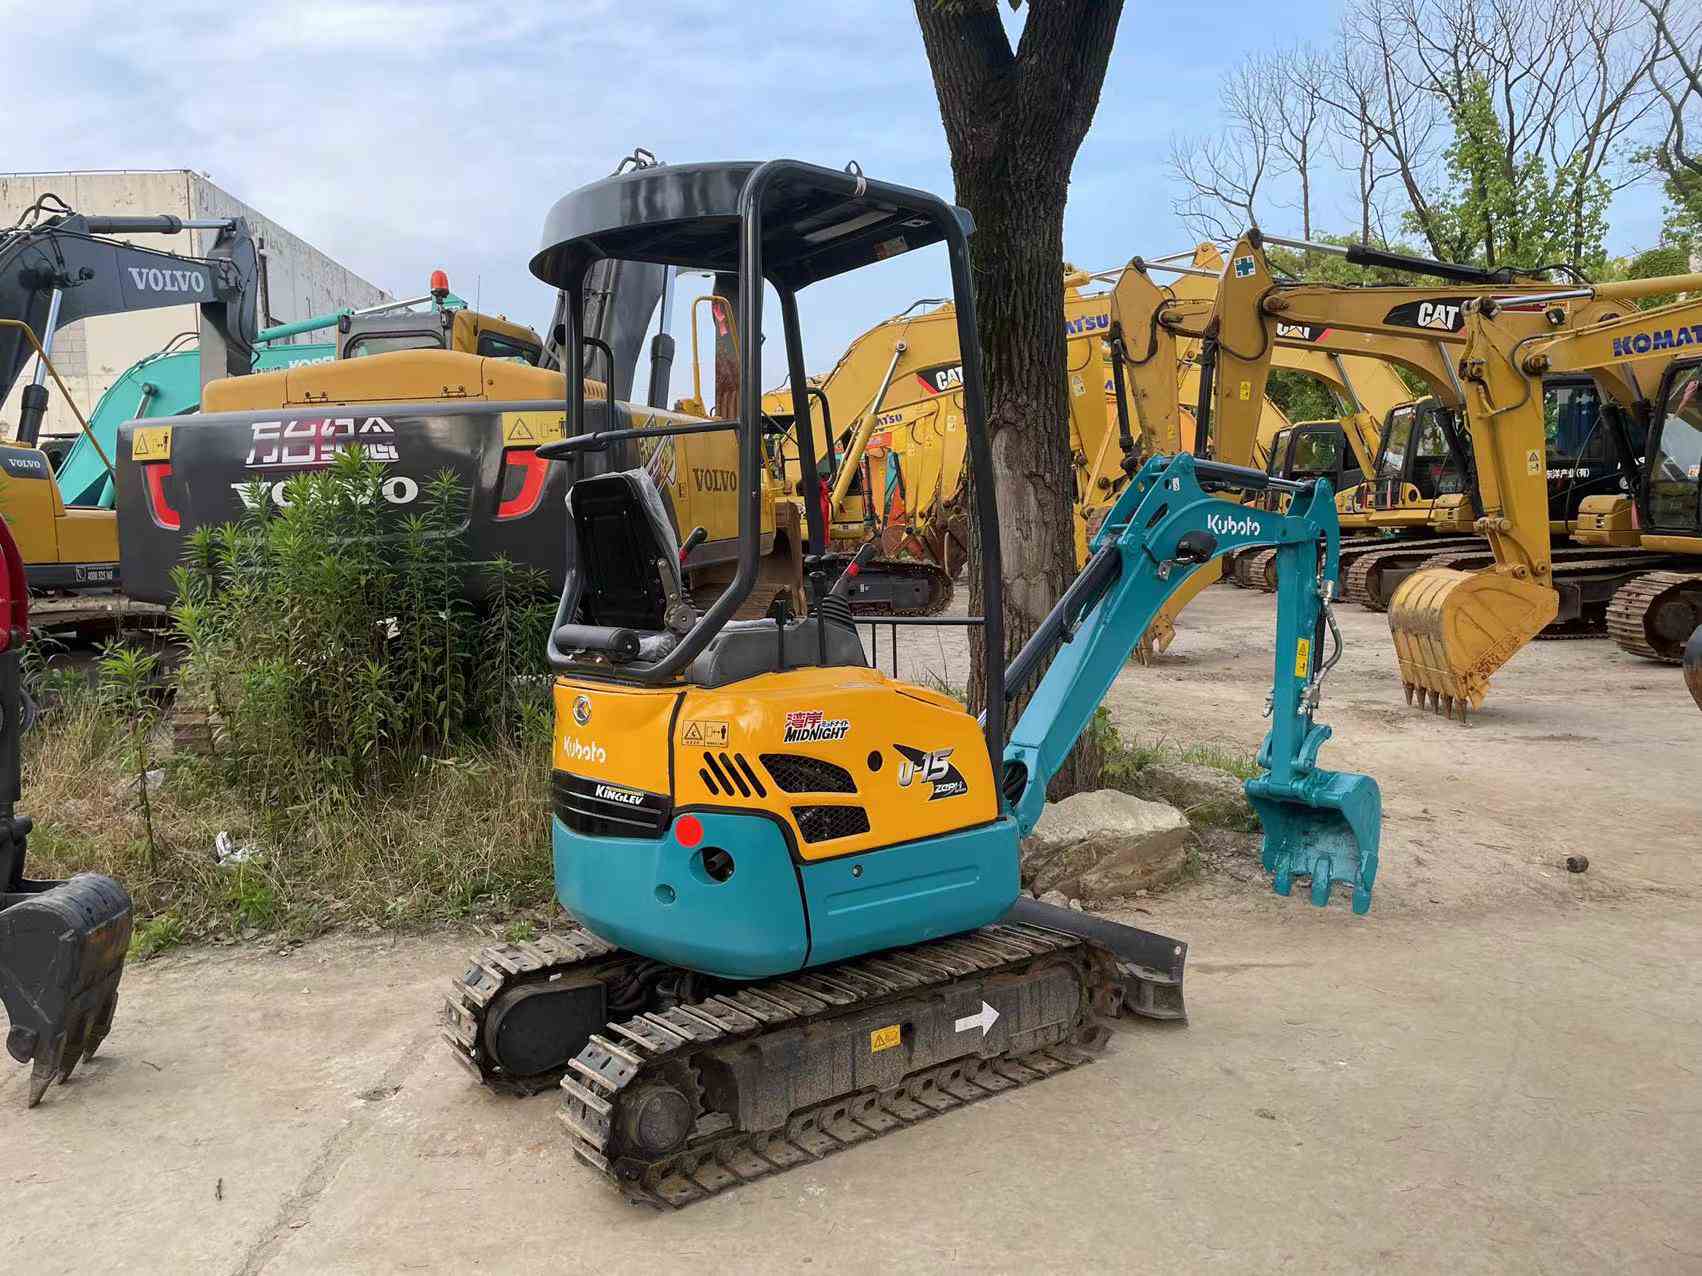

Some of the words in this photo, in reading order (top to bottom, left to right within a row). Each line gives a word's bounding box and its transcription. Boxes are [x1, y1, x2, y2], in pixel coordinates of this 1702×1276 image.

[128, 267, 204, 292] VOLVO
[1064, 314, 1110, 334] ATSU
[1417, 303, 1460, 330] CAT
[8, 458, 41, 469] VOLVO
[692, 468, 738, 492] VOLVO
[230, 476, 420, 510] VOVO
[1207, 513, 1261, 537] Kubota
[784, 725, 849, 743] MIDNIGHT
[562, 735, 607, 764] Kubota
[898, 749, 955, 787] U-15
